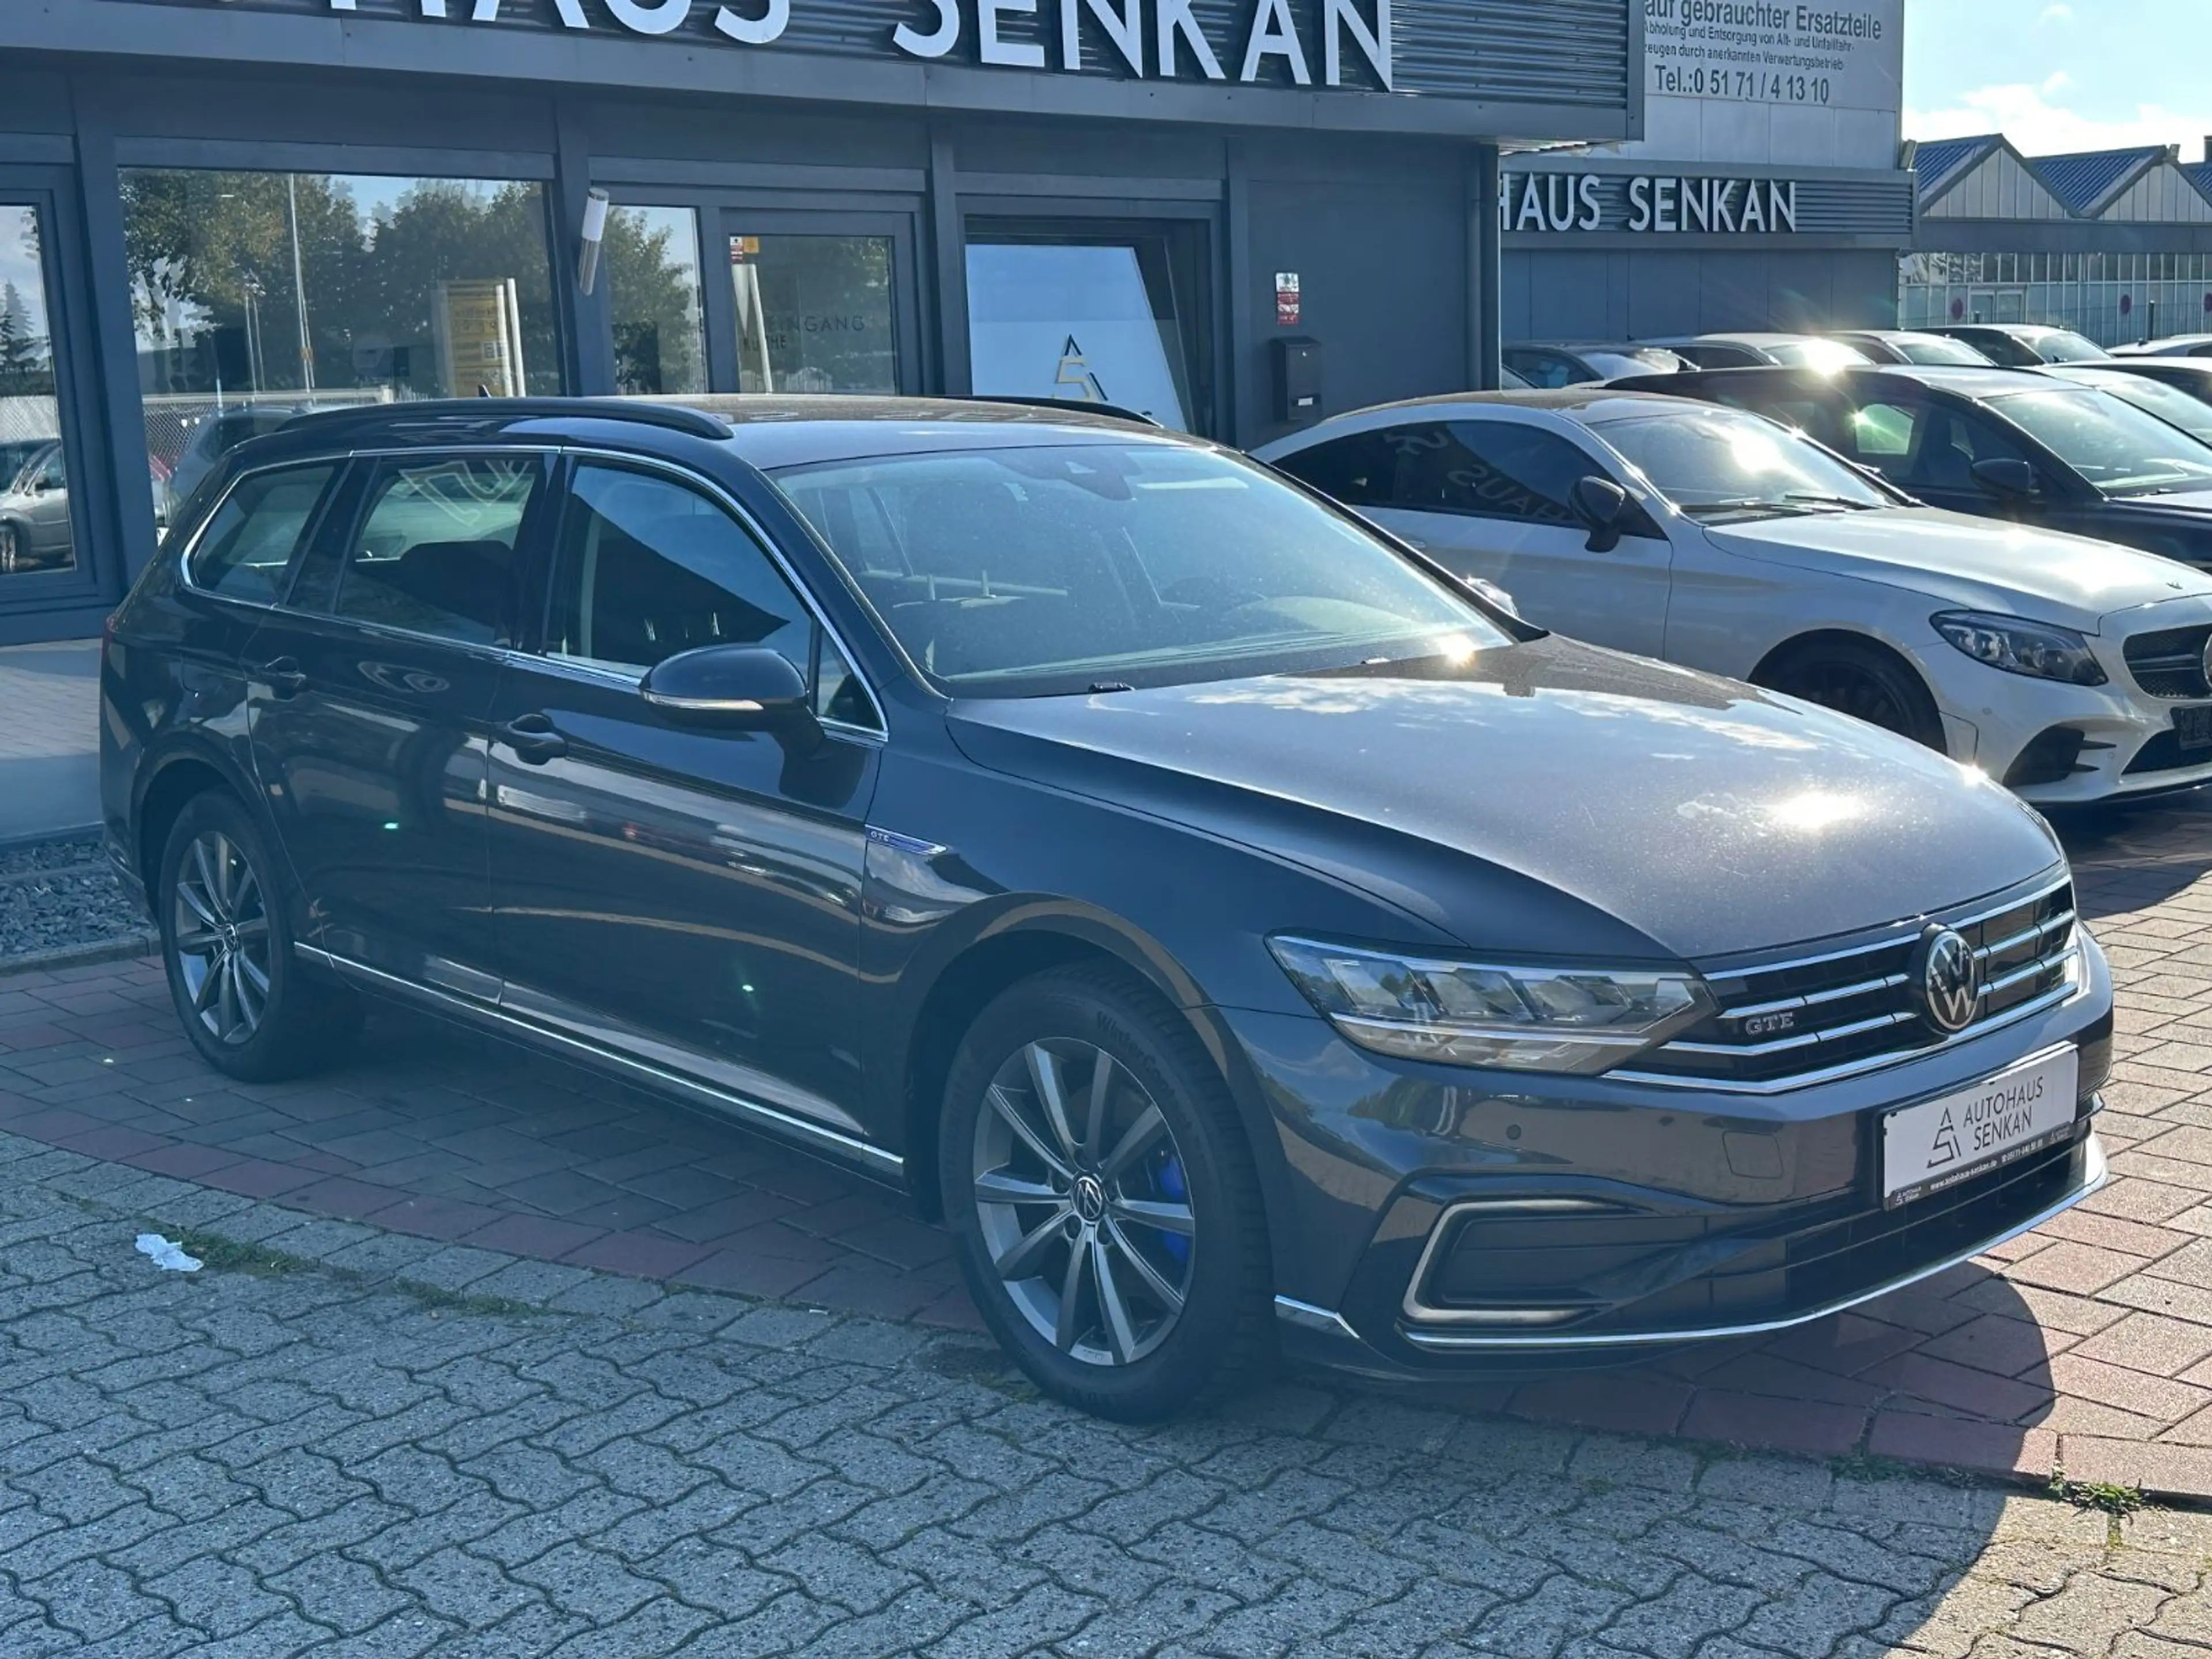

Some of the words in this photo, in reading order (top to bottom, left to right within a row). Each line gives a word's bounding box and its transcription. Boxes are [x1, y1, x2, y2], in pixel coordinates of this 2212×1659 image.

[1681, 0, 1790, 29] gebrauchter
[1796, 5, 1881, 40] Ersatzteile
[1689, 26, 1706, 38] und
[1709, 26, 1756, 46] Entsorgung
[1759, 33, 1775, 45] von
[1794, 36, 1810, 48] und
[1679, 44, 1705, 58] durch
[1707, 48, 1760, 62] anerkannten
[1628, 176, 1796, 232] SENKAN
[767, 315, 865, 332] EINGANG
[870, 831, 890, 842] GTE
[1745, 1012, 1794, 1036] GTE
[1963, 1075, 2043, 1128] AUTOHAUS
[1974, 1106, 2032, 1151] SENKAN
